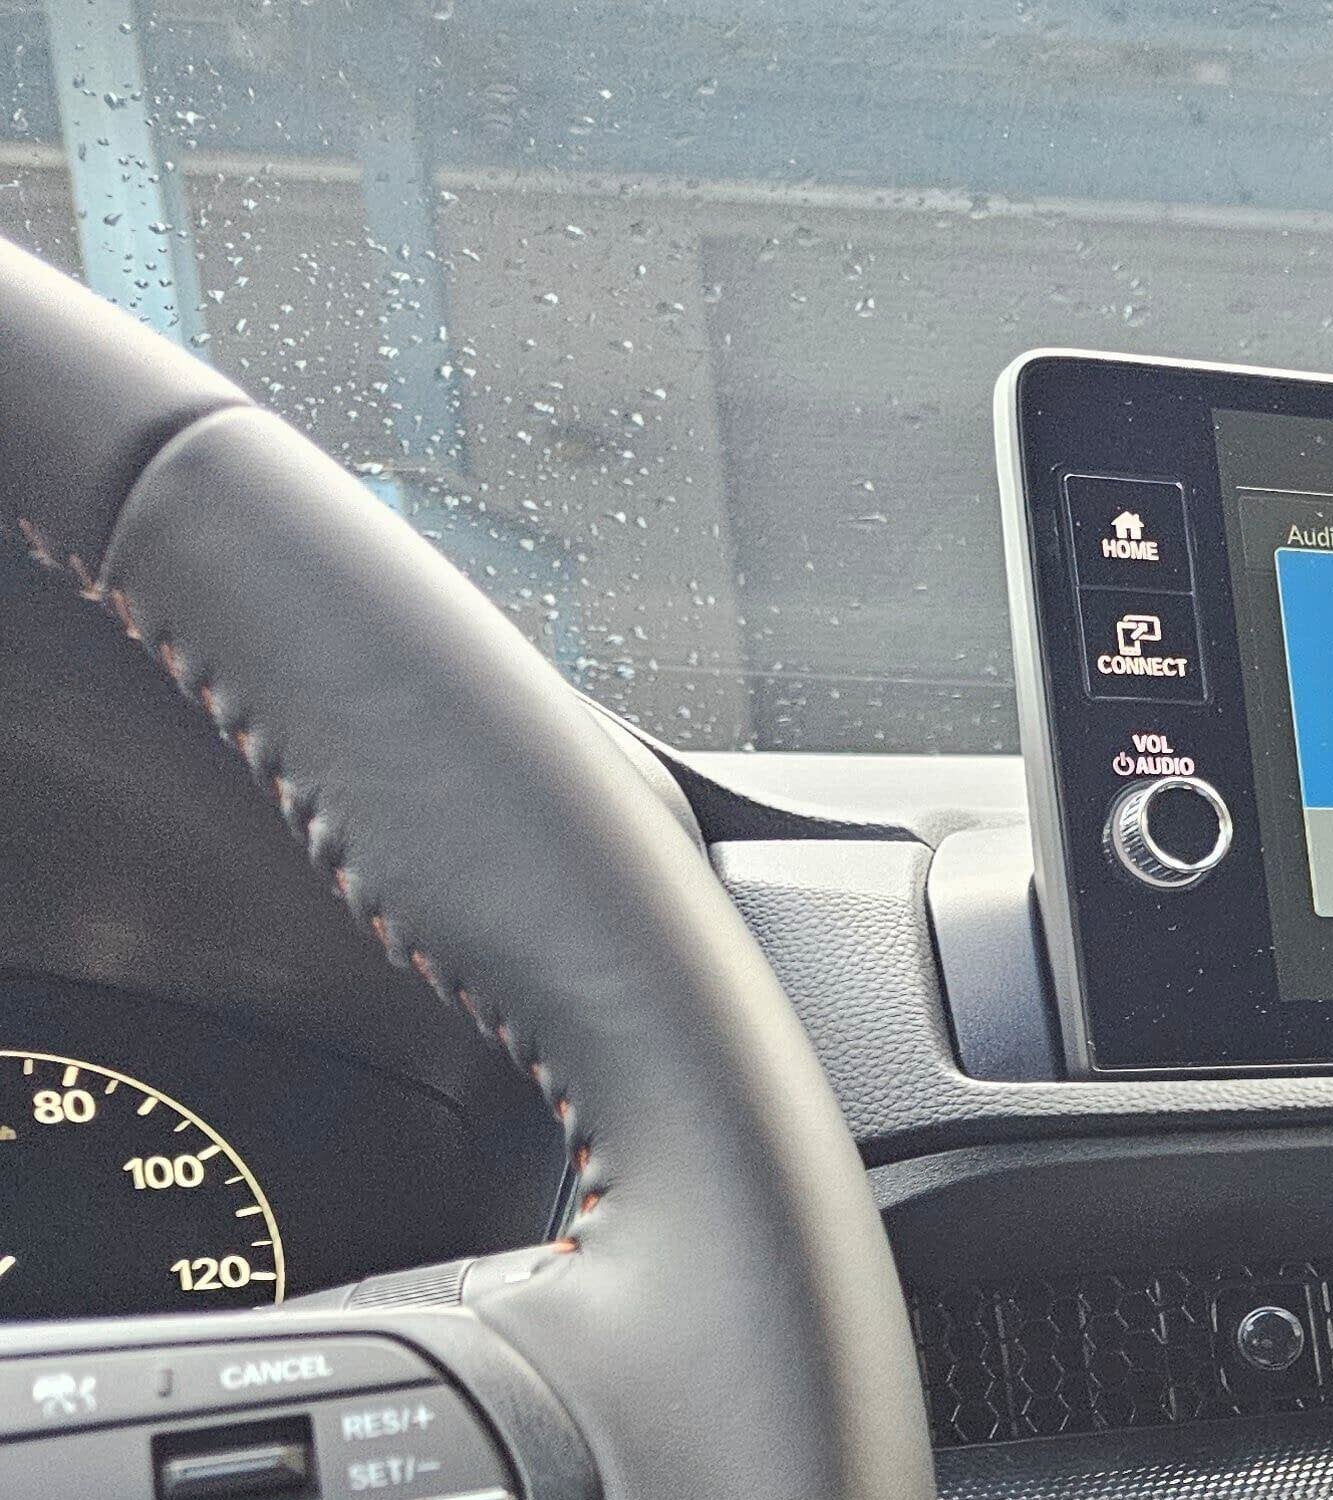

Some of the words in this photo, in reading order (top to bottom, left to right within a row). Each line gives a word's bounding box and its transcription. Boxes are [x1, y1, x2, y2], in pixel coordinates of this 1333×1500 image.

[1101, 538, 1160, 561] HOME
[1097, 655, 1188, 678] CONNECT
[1132, 734, 1174, 755] VOL
[1136, 756, 1195, 776] AUDIO
[32, 1089, 96, 1125] 80
[122, 1155, 205, 1190] 100
[170, 1256, 251, 1291] 120
[219, 1355, 333, 1390] CANCEL
[341, 1409, 436, 1441] RES/+
